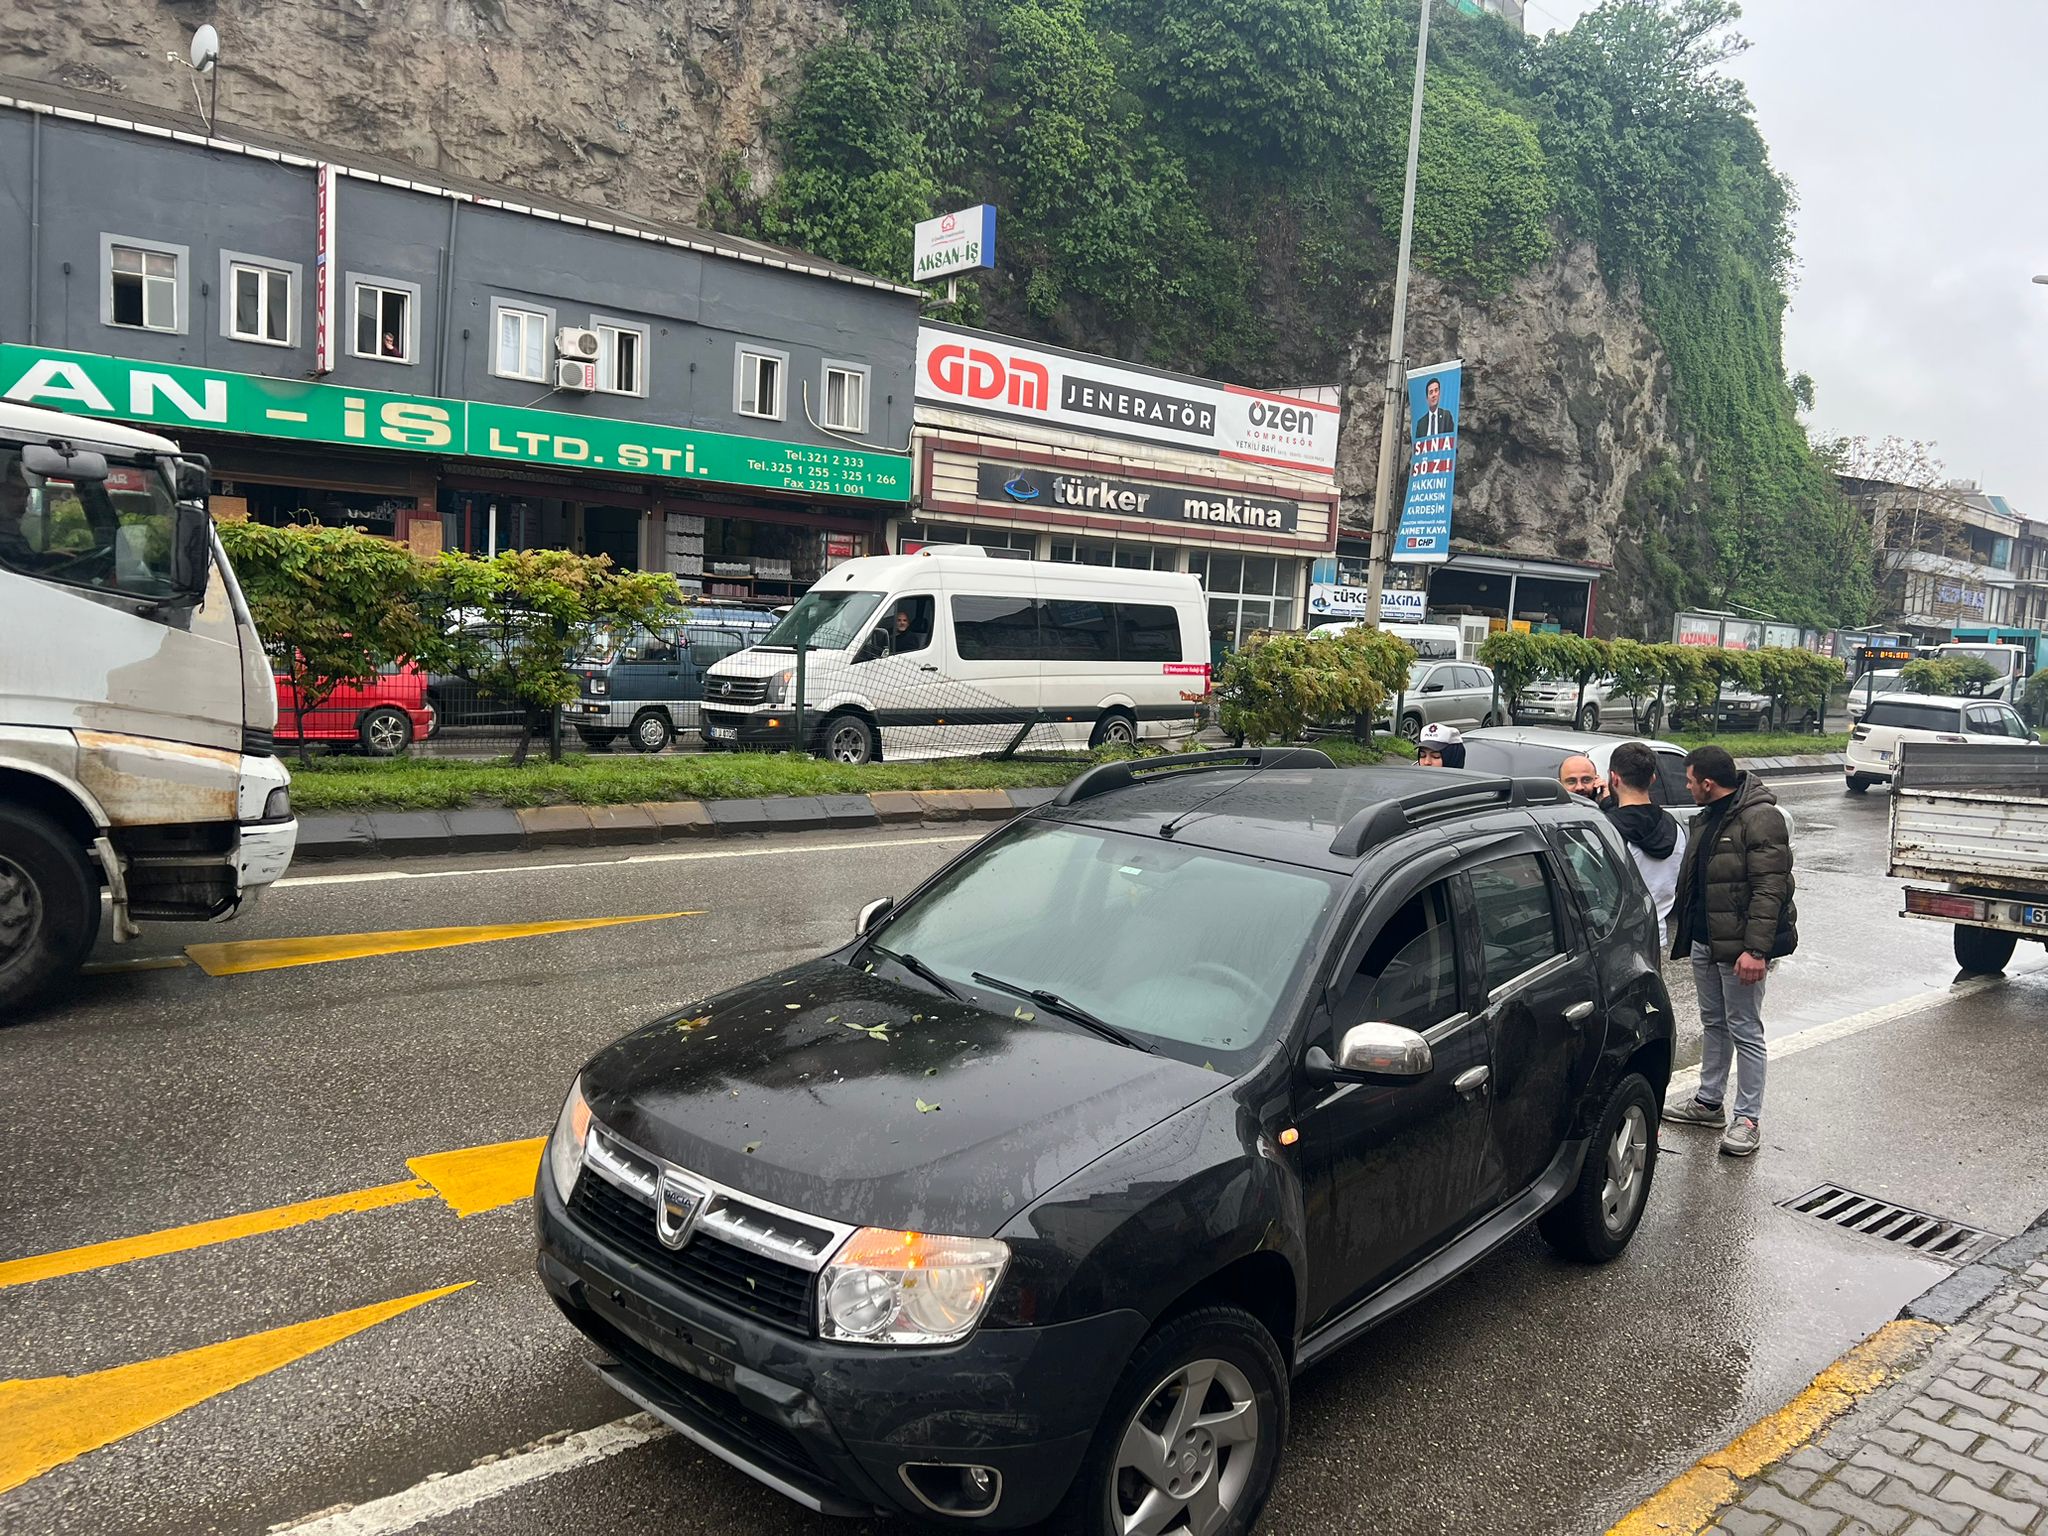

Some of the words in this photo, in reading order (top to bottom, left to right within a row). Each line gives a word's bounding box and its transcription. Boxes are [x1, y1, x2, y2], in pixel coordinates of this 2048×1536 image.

[318, 169, 327, 251] OTEL
[3, 358, 228, 423] AN
[1067, 384, 1212, 430] JENERATÖR
[489, 428, 604, 463] LTD.
[1414, 436, 1452, 456] SANA
[832, 455, 840, 465] 2
[843, 457, 864, 468] 333
[797, 466, 803, 475] 1
[808, 466, 829, 478] 255
[841, 470, 862, 481] 325
[866, 473, 872, 482] 1
[876, 474, 897, 485] 266
[783, 477, 804, 489] Fax
[809, 480, 830, 491] 325
[834, 483, 840, 492] 1
[843, 484, 864, 495] 001
[1052, 476, 1151, 513] türker
[1183, 497, 1282, 529] makina
[1426, 526, 1447, 534] KAYA
[1418, 538, 1434, 546] CHP
